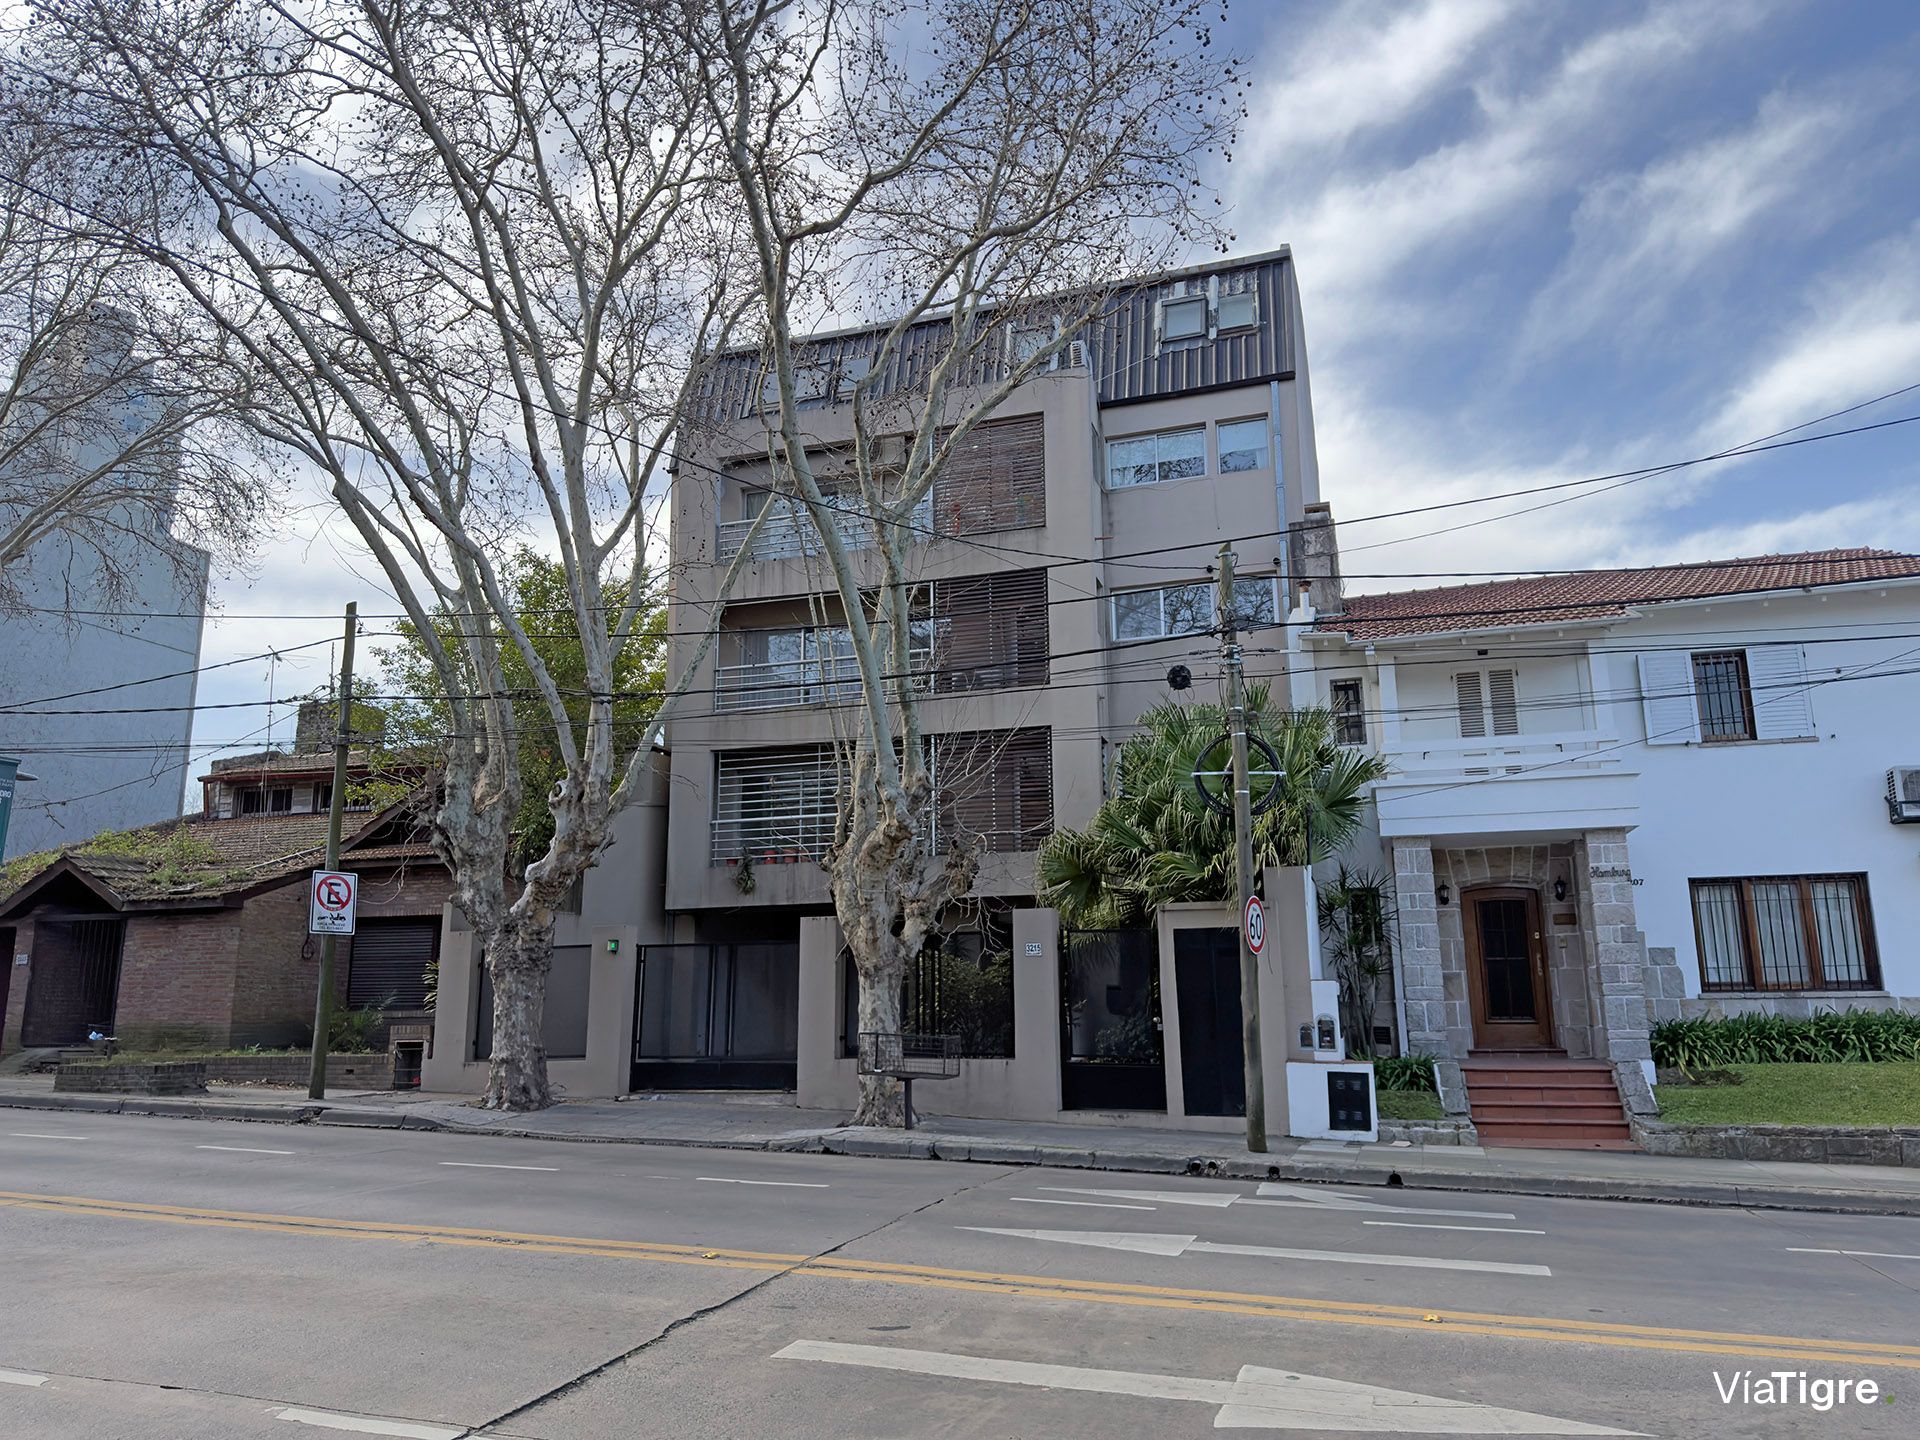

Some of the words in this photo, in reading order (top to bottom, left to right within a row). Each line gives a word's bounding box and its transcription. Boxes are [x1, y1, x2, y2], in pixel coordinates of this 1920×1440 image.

[1589, 867, 1632, 881] Hamburg
[1250, 913, 1262, 940] 60
[1026, 944, 1041, 953] 3215
